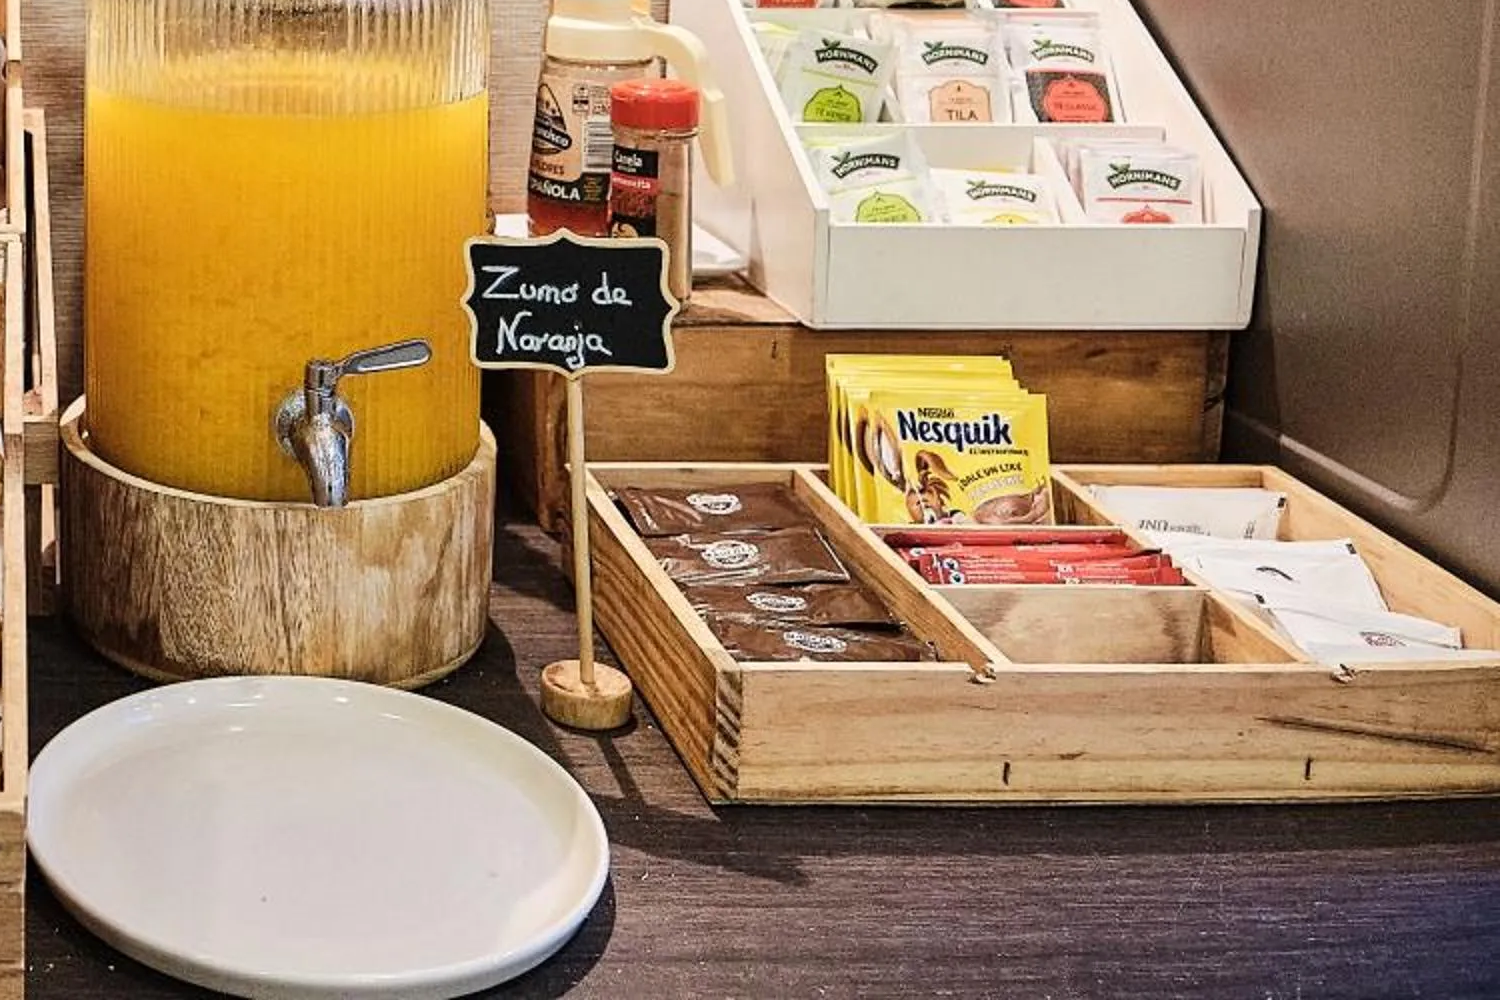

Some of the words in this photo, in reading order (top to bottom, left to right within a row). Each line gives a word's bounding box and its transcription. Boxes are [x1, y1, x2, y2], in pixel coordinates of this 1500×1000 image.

[945, 109, 978, 121] TILA
[835, 154, 898, 177] HORNIMANS
[1109, 170, 1178, 189] HORNIMANS
[481, 265, 580, 305] Zumo
[591, 271, 632, 306] de
[495, 311, 612, 369] Naranja
[897, 409, 1012, 452] Nesquik
